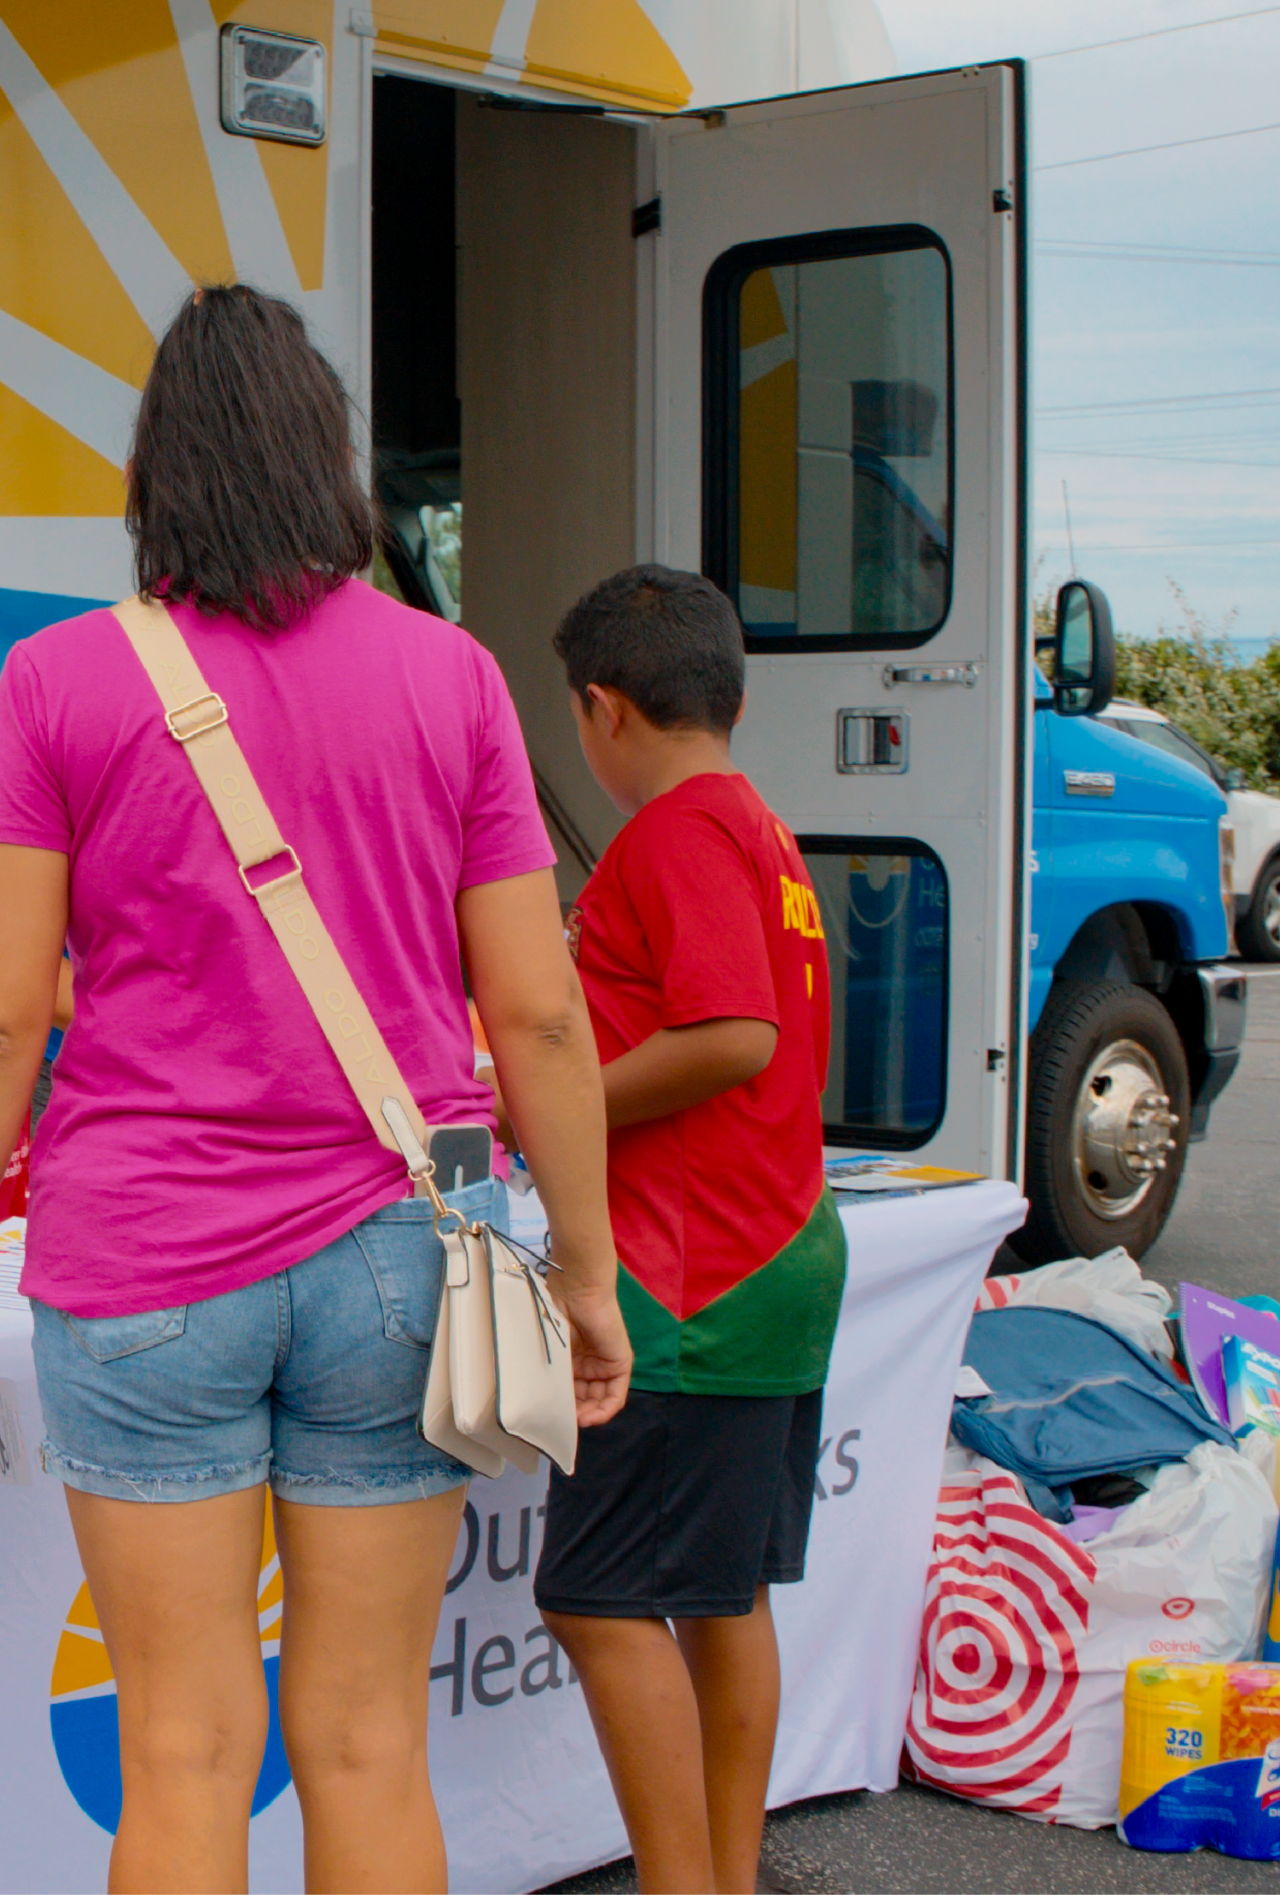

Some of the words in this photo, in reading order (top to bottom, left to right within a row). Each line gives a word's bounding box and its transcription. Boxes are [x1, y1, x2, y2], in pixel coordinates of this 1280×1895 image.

[324, 987, 389, 1086] ALDO
[429, 1617, 580, 1717] Hea
[1165, 1727, 1203, 1748] 320
[1165, 1746, 1202, 1760] WIPES
